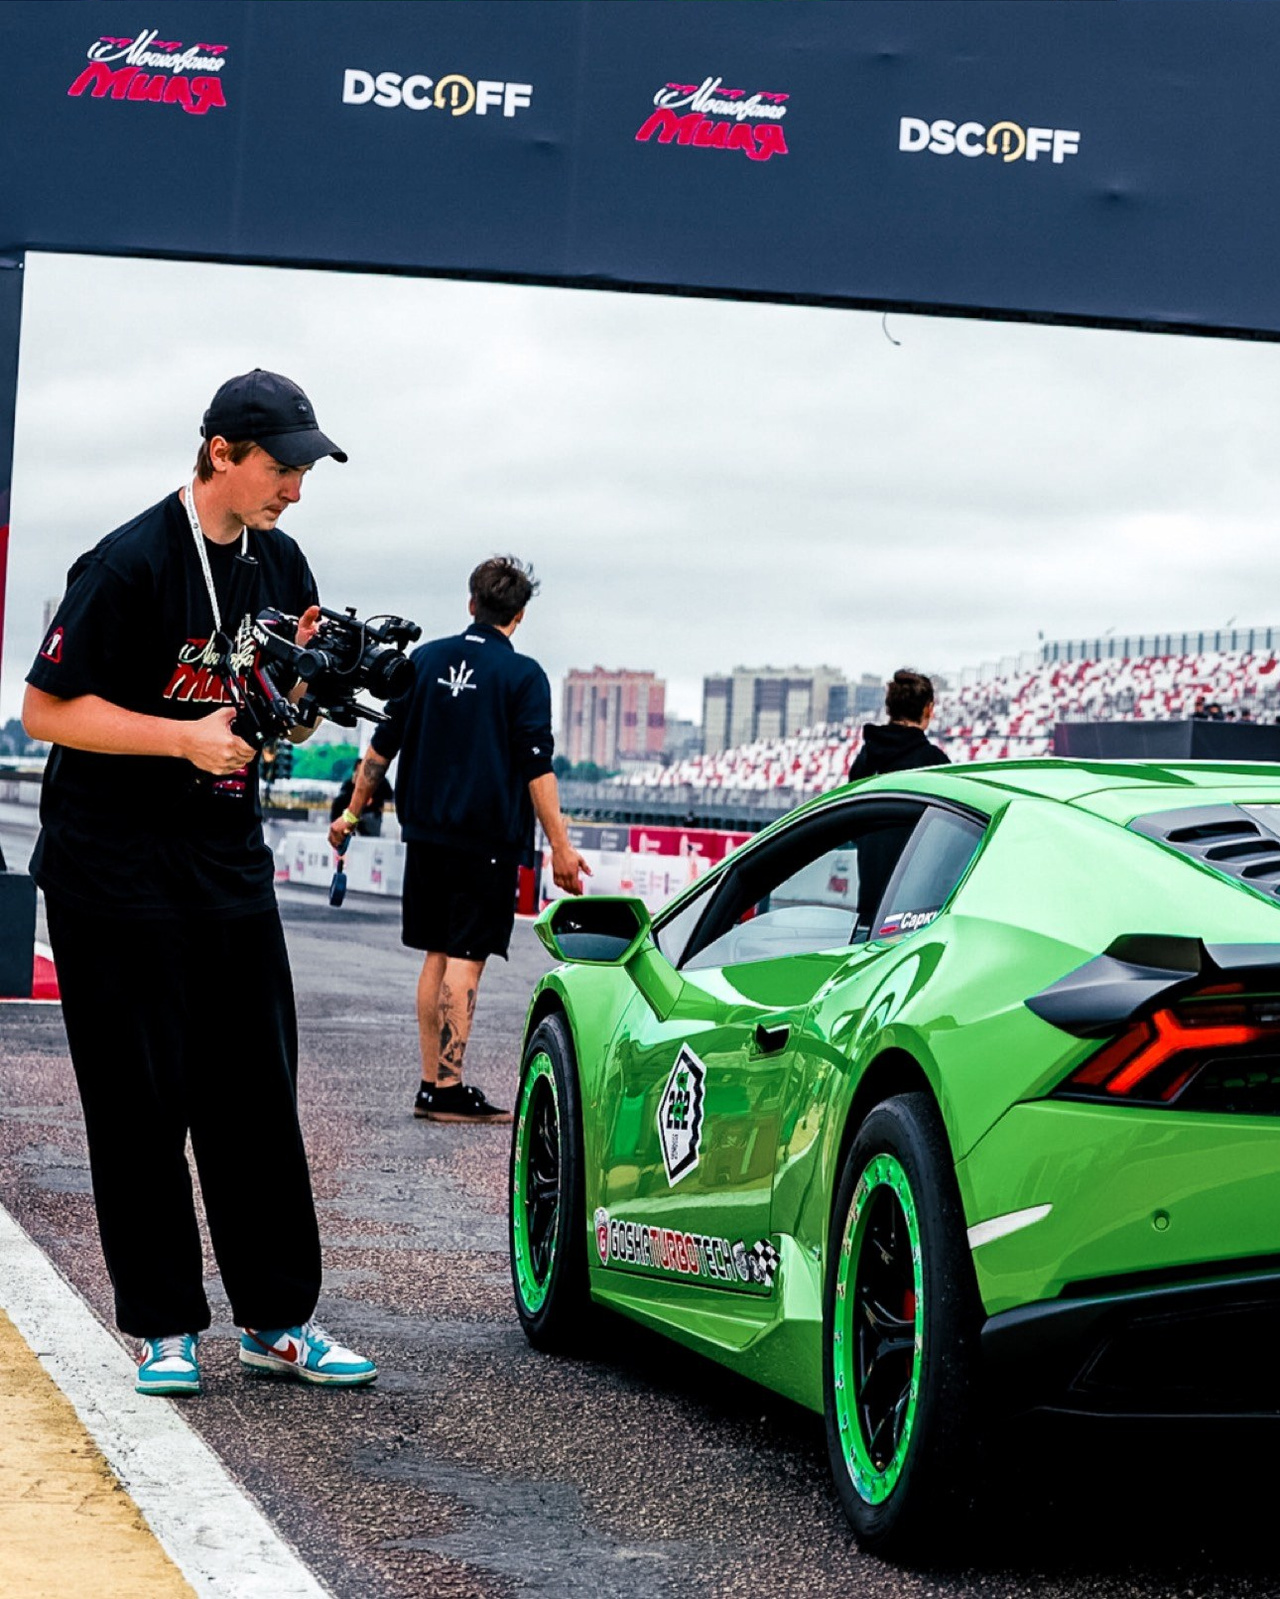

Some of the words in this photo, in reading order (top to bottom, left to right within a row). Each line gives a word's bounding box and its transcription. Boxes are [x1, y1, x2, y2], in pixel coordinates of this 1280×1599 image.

[67, 60, 227, 115] Миля
[342, 68, 533, 117] DSCOFF
[635, 106, 789, 161] Миля
[899, 116, 1081, 164] DSCOFF
